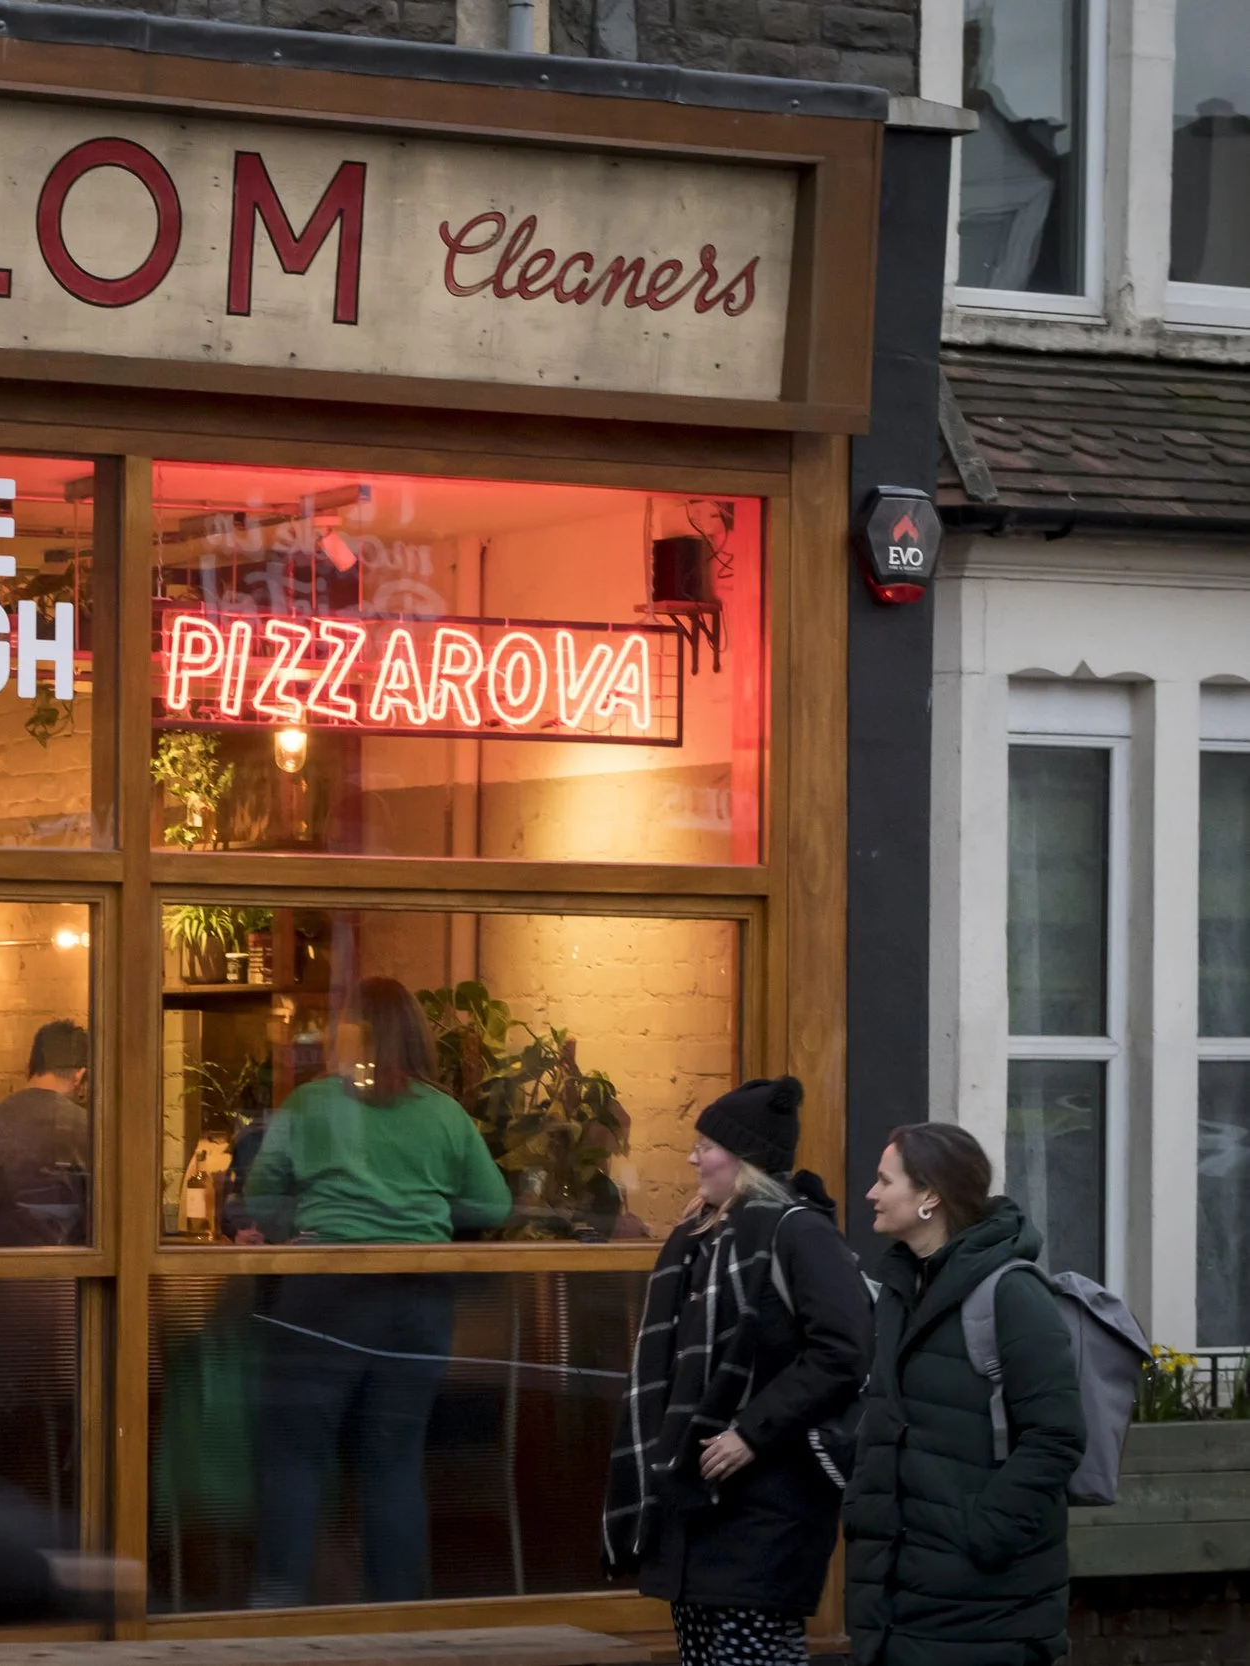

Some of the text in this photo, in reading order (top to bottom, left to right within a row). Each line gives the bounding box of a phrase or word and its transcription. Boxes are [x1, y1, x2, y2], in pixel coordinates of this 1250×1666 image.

[439, 210, 761, 317] Cleaners
[888, 546, 924, 566] EVO
[166, 613, 653, 730] PIZZAROVA
